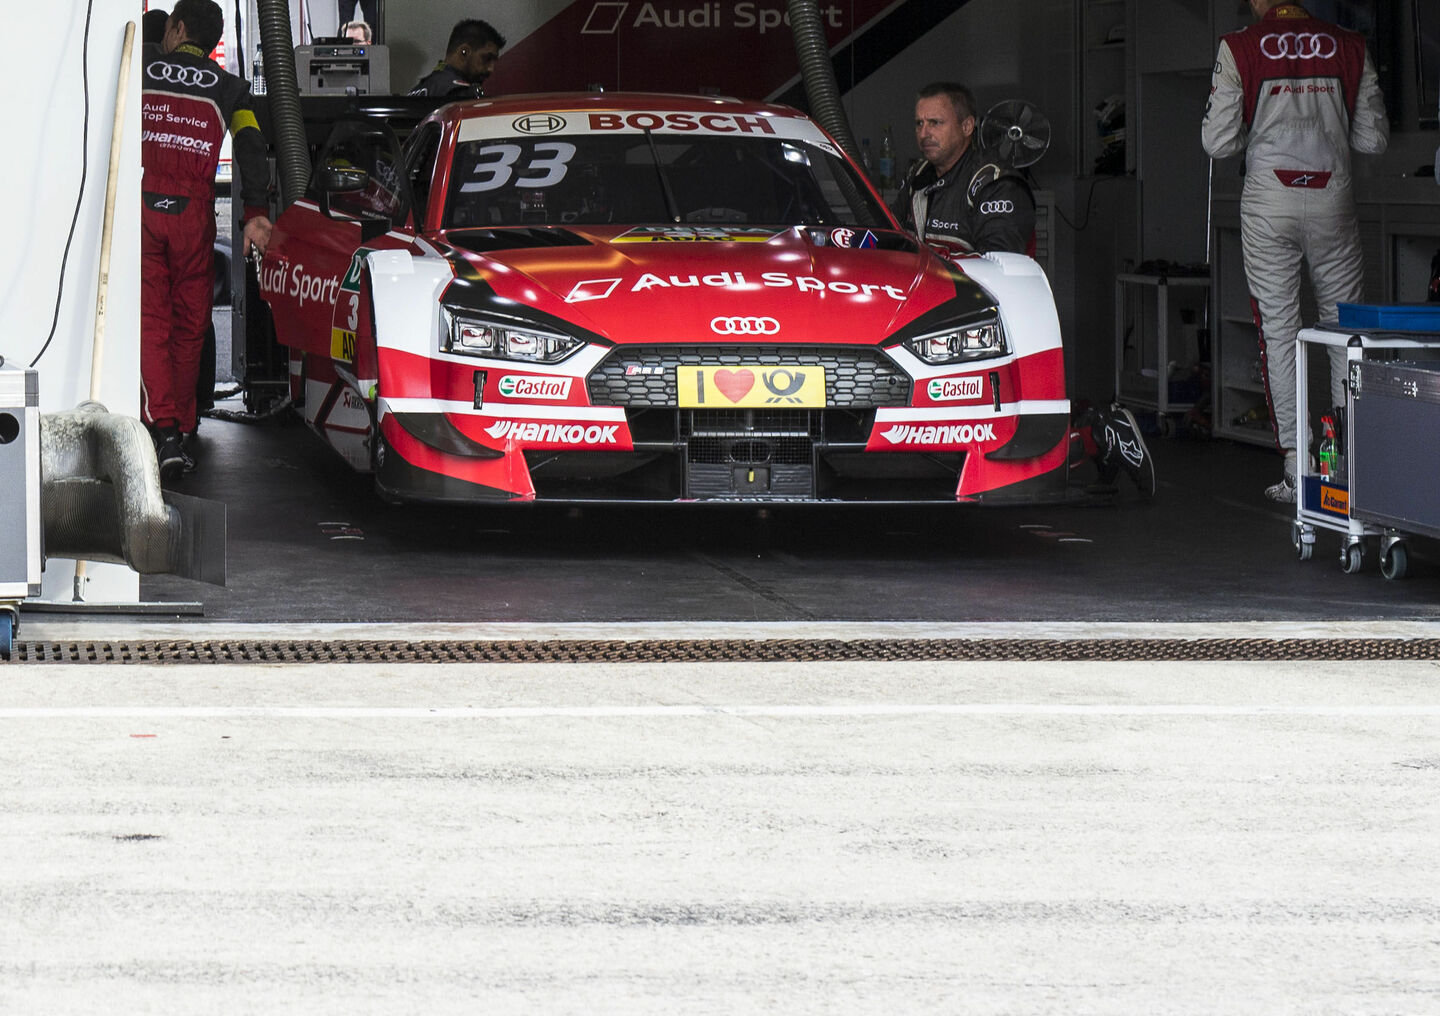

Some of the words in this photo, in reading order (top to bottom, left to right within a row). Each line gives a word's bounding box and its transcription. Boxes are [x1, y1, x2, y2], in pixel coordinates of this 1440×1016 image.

[633, 2, 721, 28] Audi
[734, 3, 843, 34] Spt
[1283, 85, 1305, 94] Audi
[1307, 84, 1335, 94] Sport
[142, 103, 170, 113] Audi
[142, 111, 164, 122] Top
[166, 113, 209, 129] Service
[588, 112, 776, 135] BOSCH
[460, 141, 577, 193] 33
[931, 219, 959, 231] Sport
[260, 259, 290, 294] udi
[290, 263, 340, 307] Sport
[630, 271, 745, 292] Audi
[760, 271, 908, 301] Sport
[514, 377, 567, 397] Castrol
[941, 378, 980, 397] Castrol
